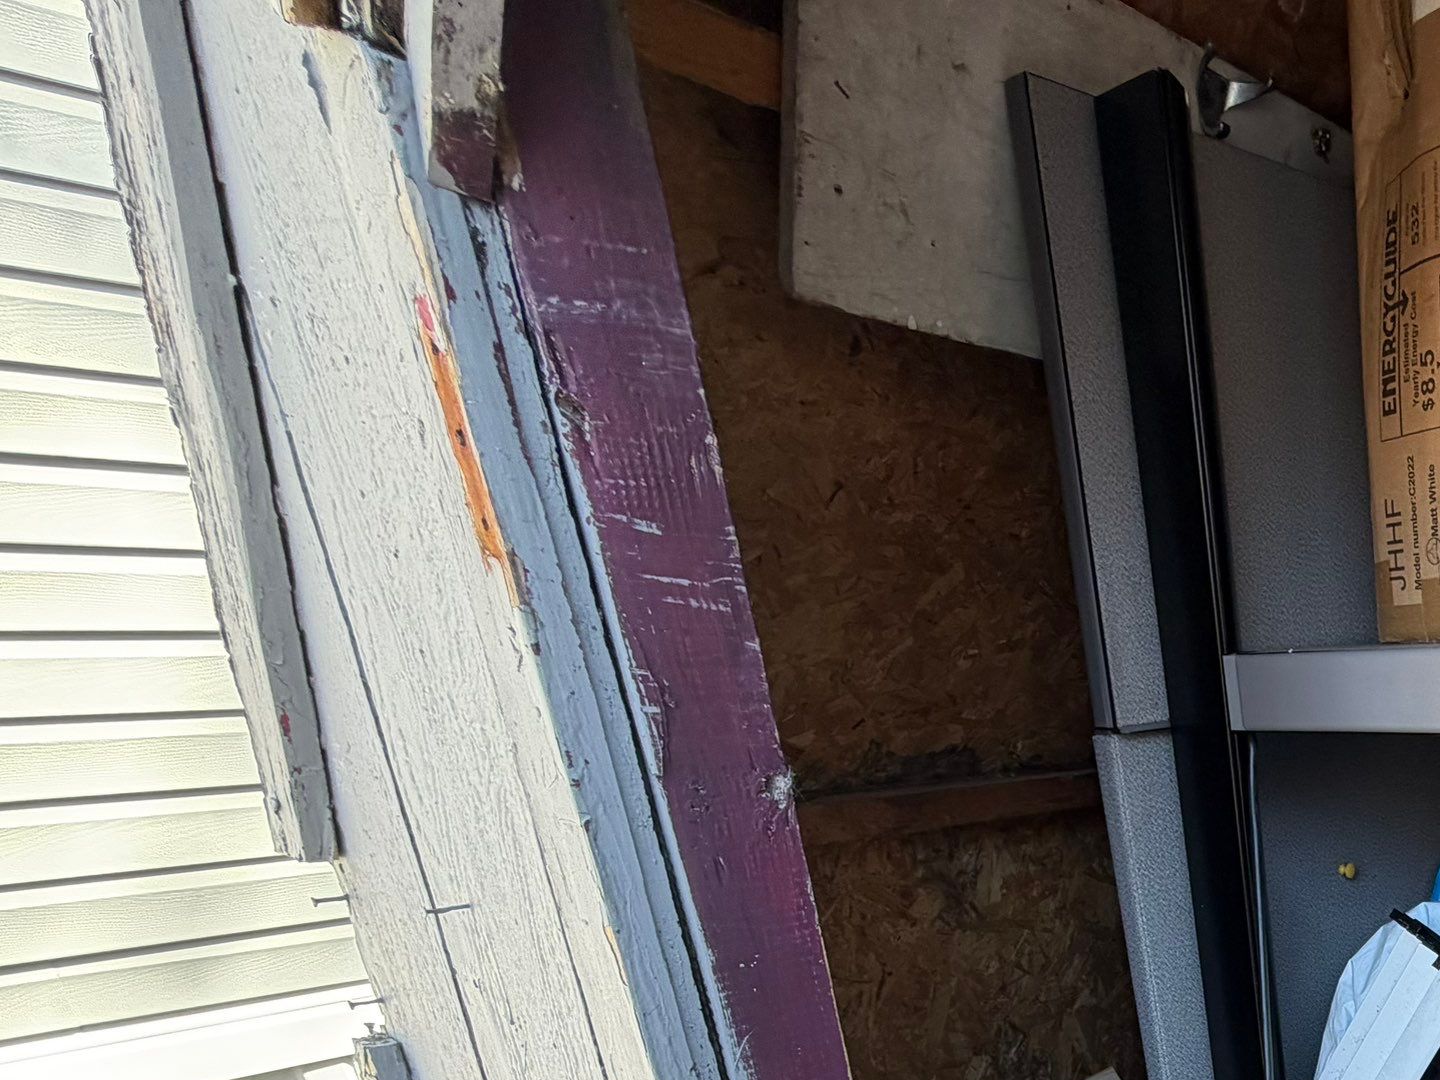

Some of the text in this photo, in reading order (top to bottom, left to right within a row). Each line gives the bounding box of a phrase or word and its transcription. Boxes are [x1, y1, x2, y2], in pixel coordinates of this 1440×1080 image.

[1411, 202, 1420, 246] 532
[1382, 203, 1400, 417] ENERGYGUIDE
[1411, 324, 1419, 367] Energy
[1412, 369, 1420, 407] Yearly
[1419, 349, 1435, 412] $8.5
[1428, 464, 1438, 537] Matt White
[1385, 499, 1407, 591] JHHF
[1413, 552, 1422, 590] Model
